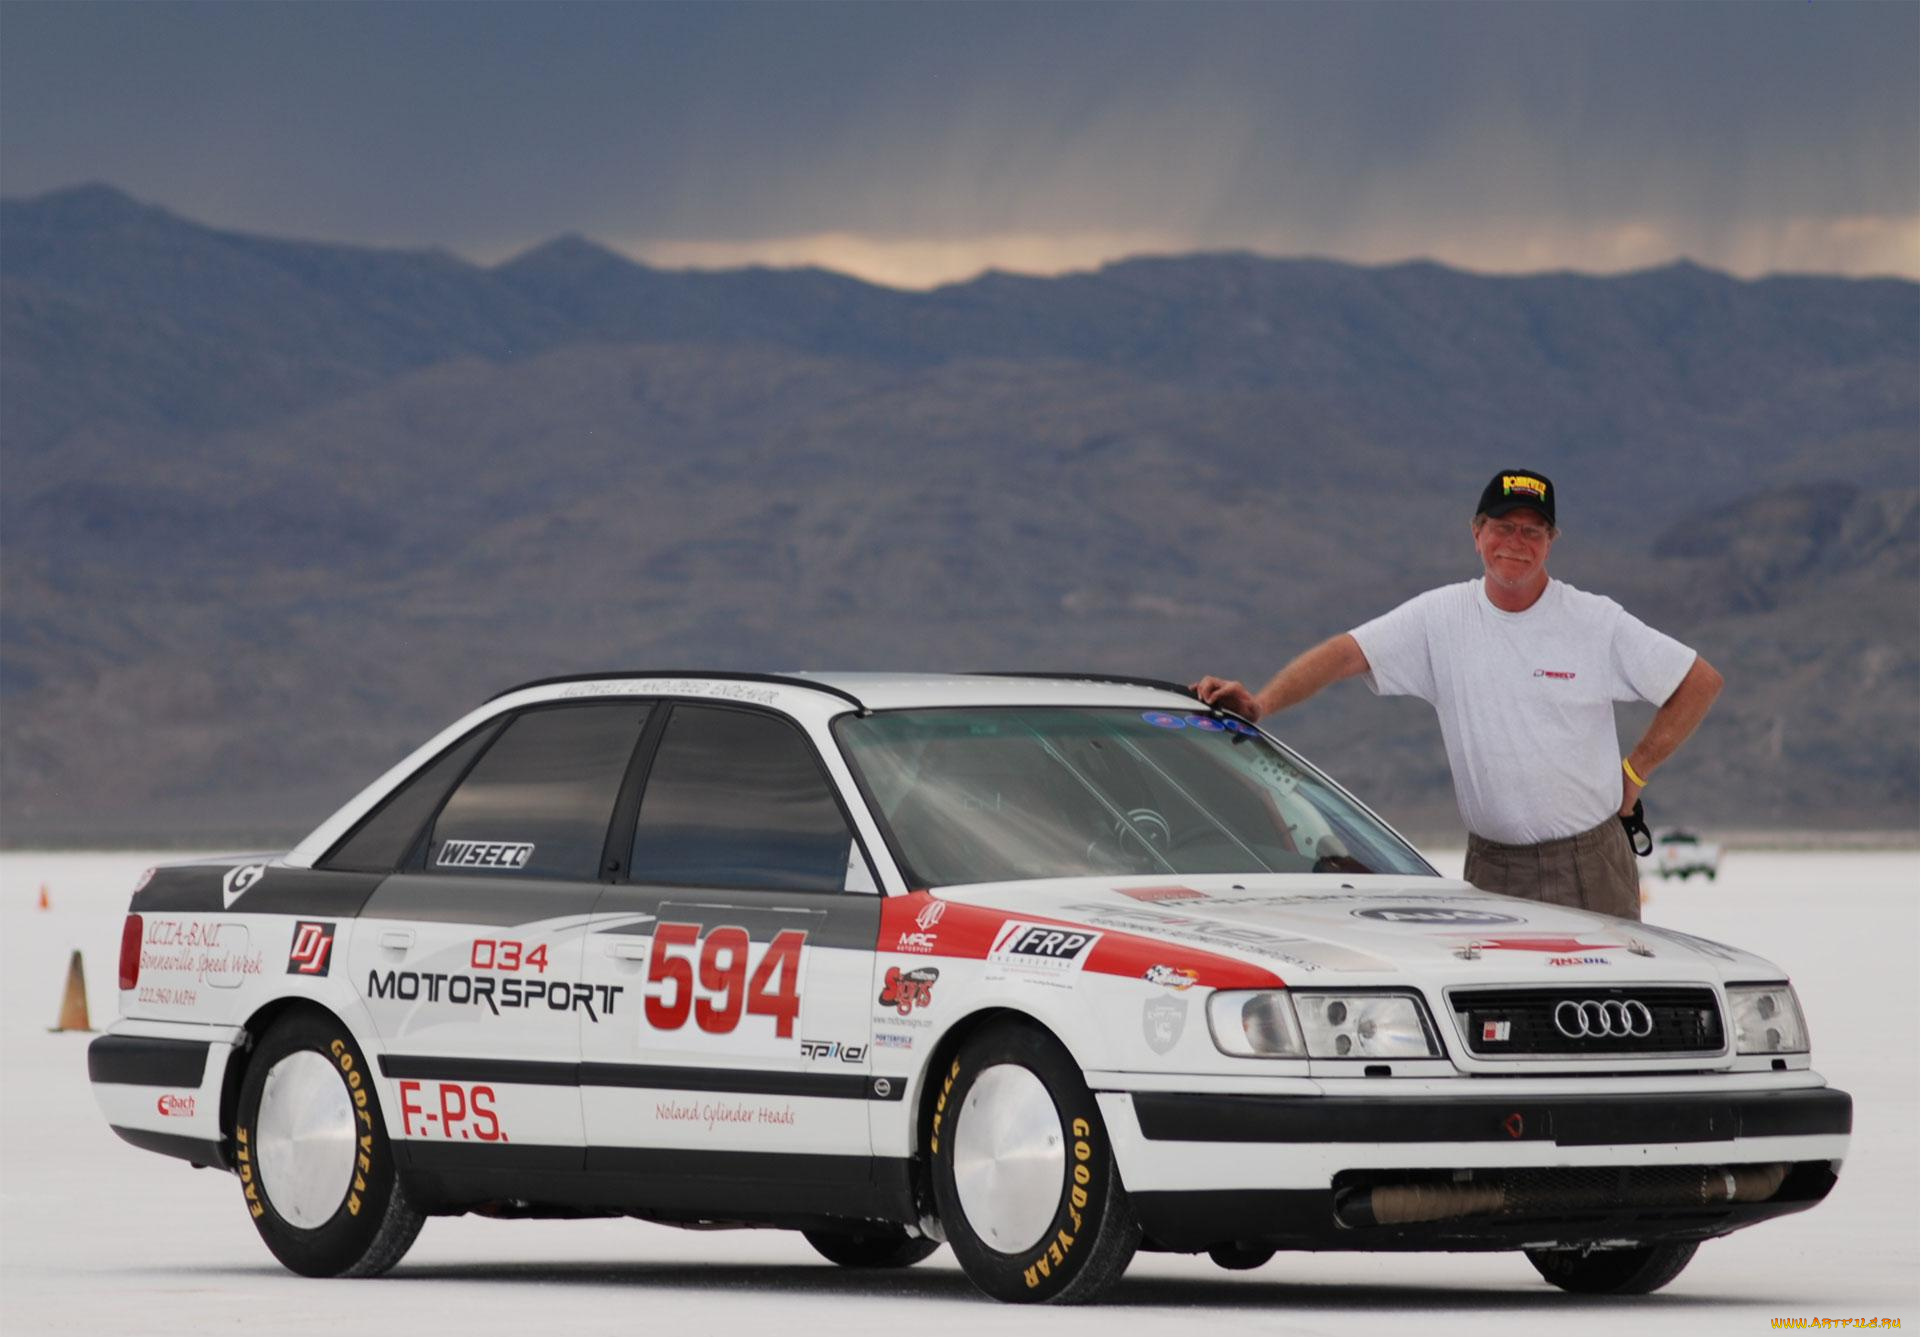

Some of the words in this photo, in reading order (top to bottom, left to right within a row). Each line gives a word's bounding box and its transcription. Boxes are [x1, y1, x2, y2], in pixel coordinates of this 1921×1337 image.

[471, 938, 548, 973] 034
[1017, 929, 1087, 956] FRP
[196, 949, 230, 983] Speed
[231, 949, 263, 974] Week
[644, 921, 809, 1039] 594
[367, 969, 624, 1023] MOTORSPORT
[655, 1100, 700, 1121] Noland
[703, 1102, 754, 1131] Cylinder
[757, 1106, 795, 1126] Heads
[236, 1125, 265, 1219] EAGLE
